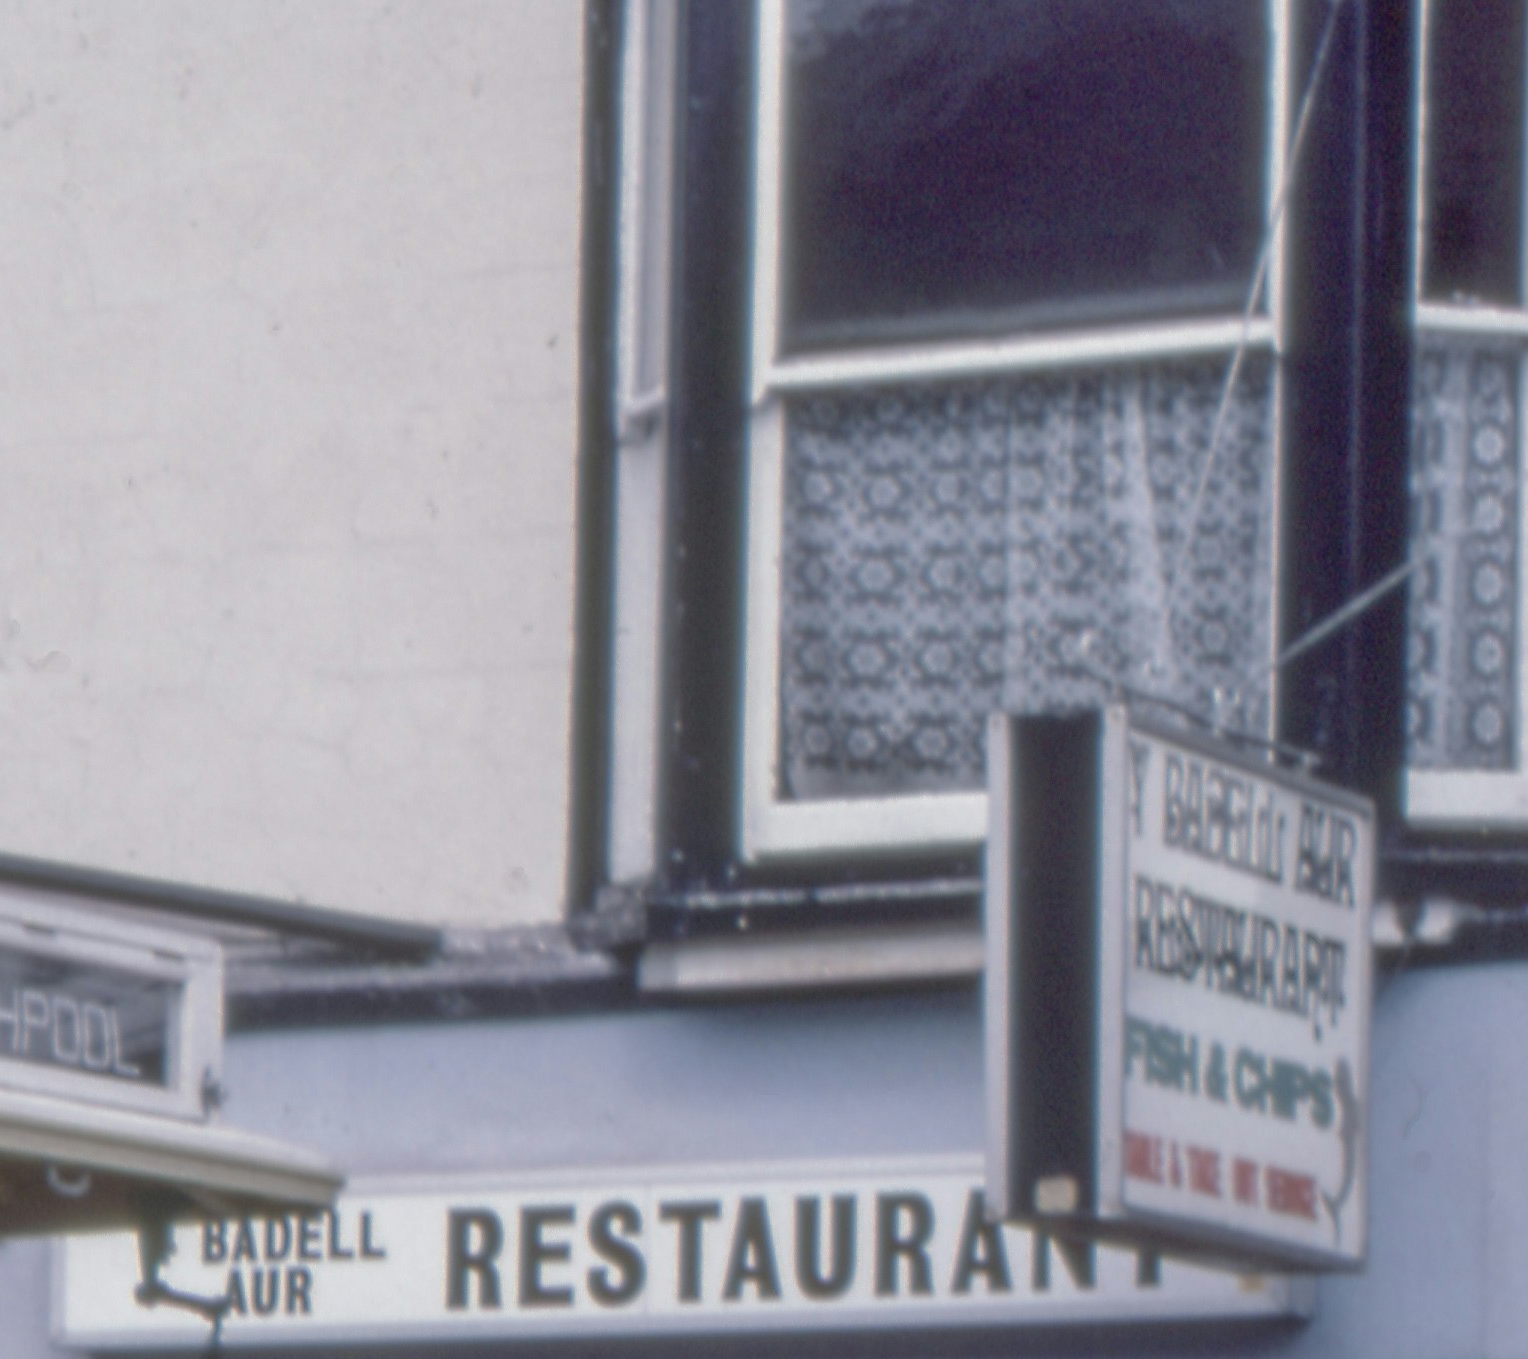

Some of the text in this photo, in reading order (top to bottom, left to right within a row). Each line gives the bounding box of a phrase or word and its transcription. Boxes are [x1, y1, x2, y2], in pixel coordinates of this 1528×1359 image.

[1124, 1014, 1200, 1100] FISH
[1232, 1048, 1334, 1130] CHIPS
[202, 1206, 387, 1263] BADELL
[226, 1265, 313, 1316] AUR
